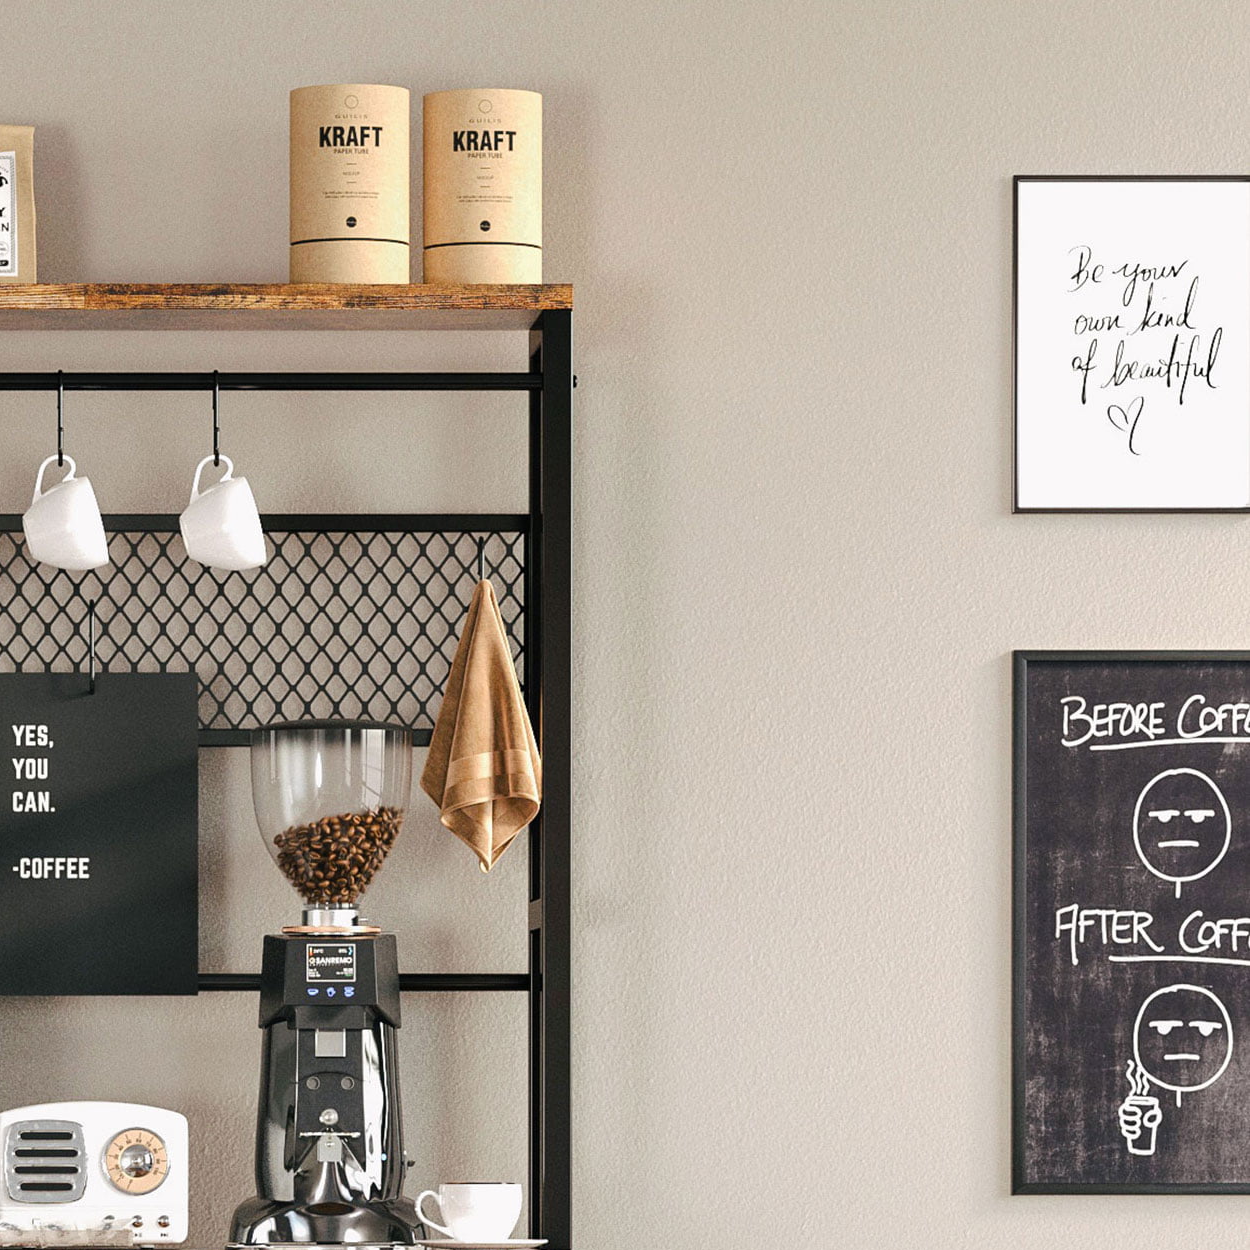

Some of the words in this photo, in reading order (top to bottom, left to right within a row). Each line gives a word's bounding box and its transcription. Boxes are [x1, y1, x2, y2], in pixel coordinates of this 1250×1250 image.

[319, 126, 383, 148] KRAFT
[453, 130, 516, 152] KRAFT
[1067, 245, 1104, 292] Be
[1112, 260, 1188, 307] your
[1074, 313, 1124, 335] own
[1126, 276, 1199, 335] kind
[1072, 338, 1098, 405] of
[1100, 327, 1223, 405] beautiful
[1060, 695, 1166, 747] BEFORE
[12, 725, 54, 749] YES,
[12, 758, 49, 780] YOU
[12, 791, 56, 813] CAN.
[12, 857, 90, 879] -COFFEE
[1055, 903, 1165, 965] AFTER
[1178, 910, 1250, 954] COFF
[316, 956, 352, 964] SANREMO
